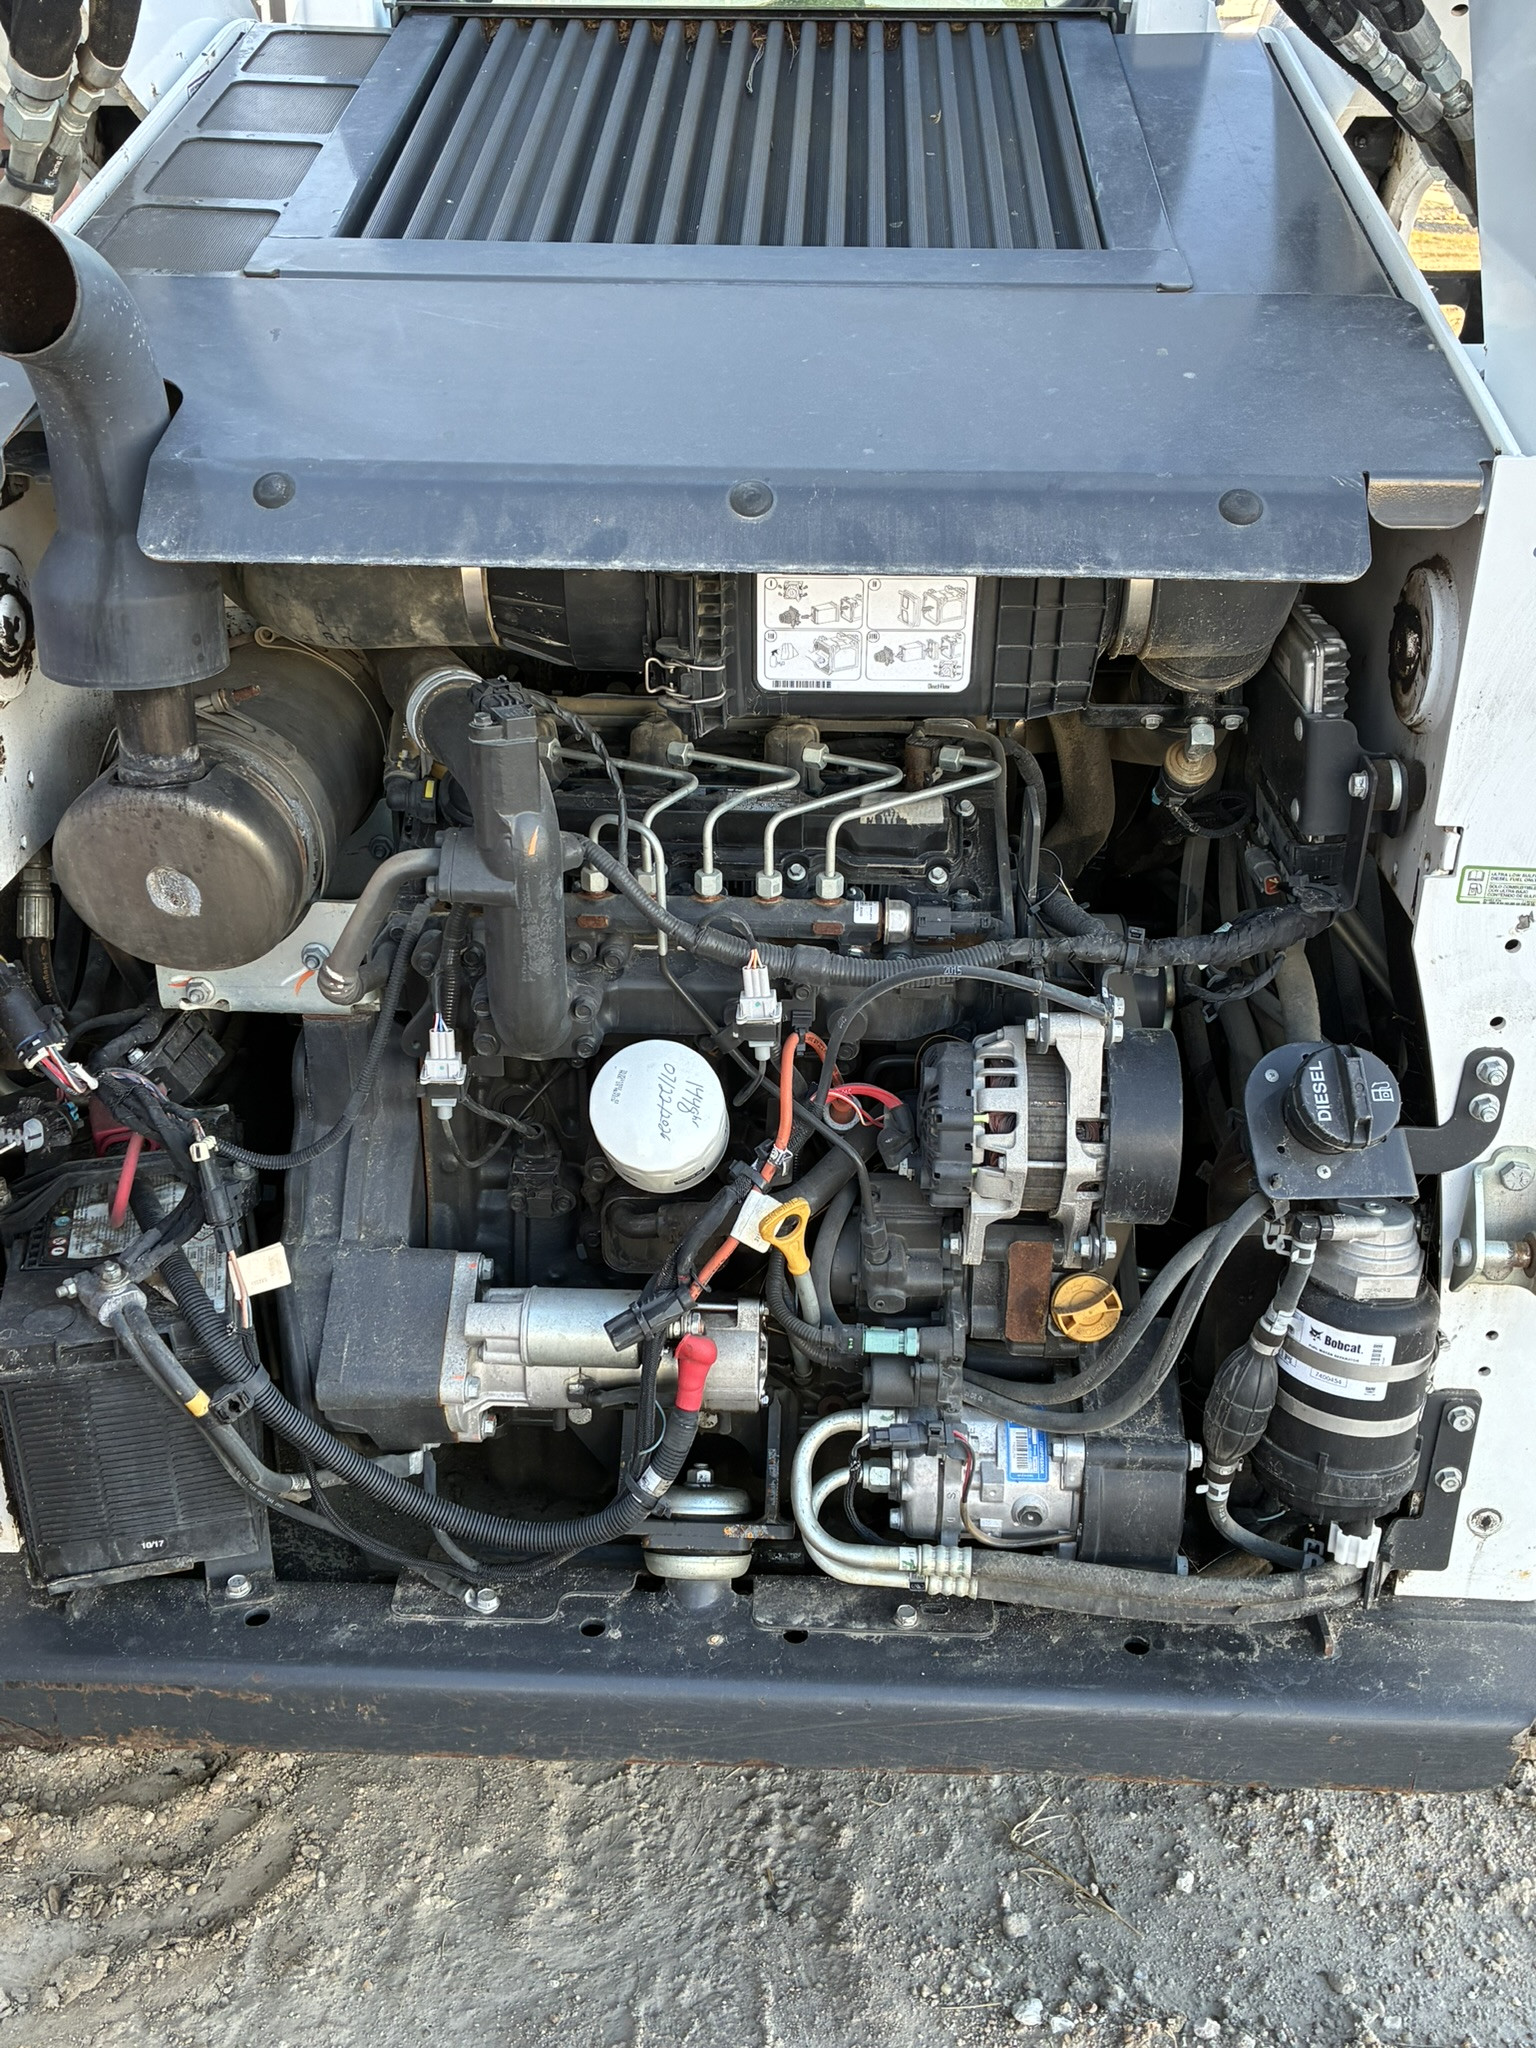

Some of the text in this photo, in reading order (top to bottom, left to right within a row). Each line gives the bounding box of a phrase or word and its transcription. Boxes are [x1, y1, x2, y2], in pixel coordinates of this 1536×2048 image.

[943, 965, 962, 976] 2015
[1309, 1060, 1332, 1122] DIESEL
[1324, 1335, 1362, 1354] Bobcat
[1334, 1354, 1360, 1363] SEPARATOR
[141, 1539, 165, 1550] 10/17
